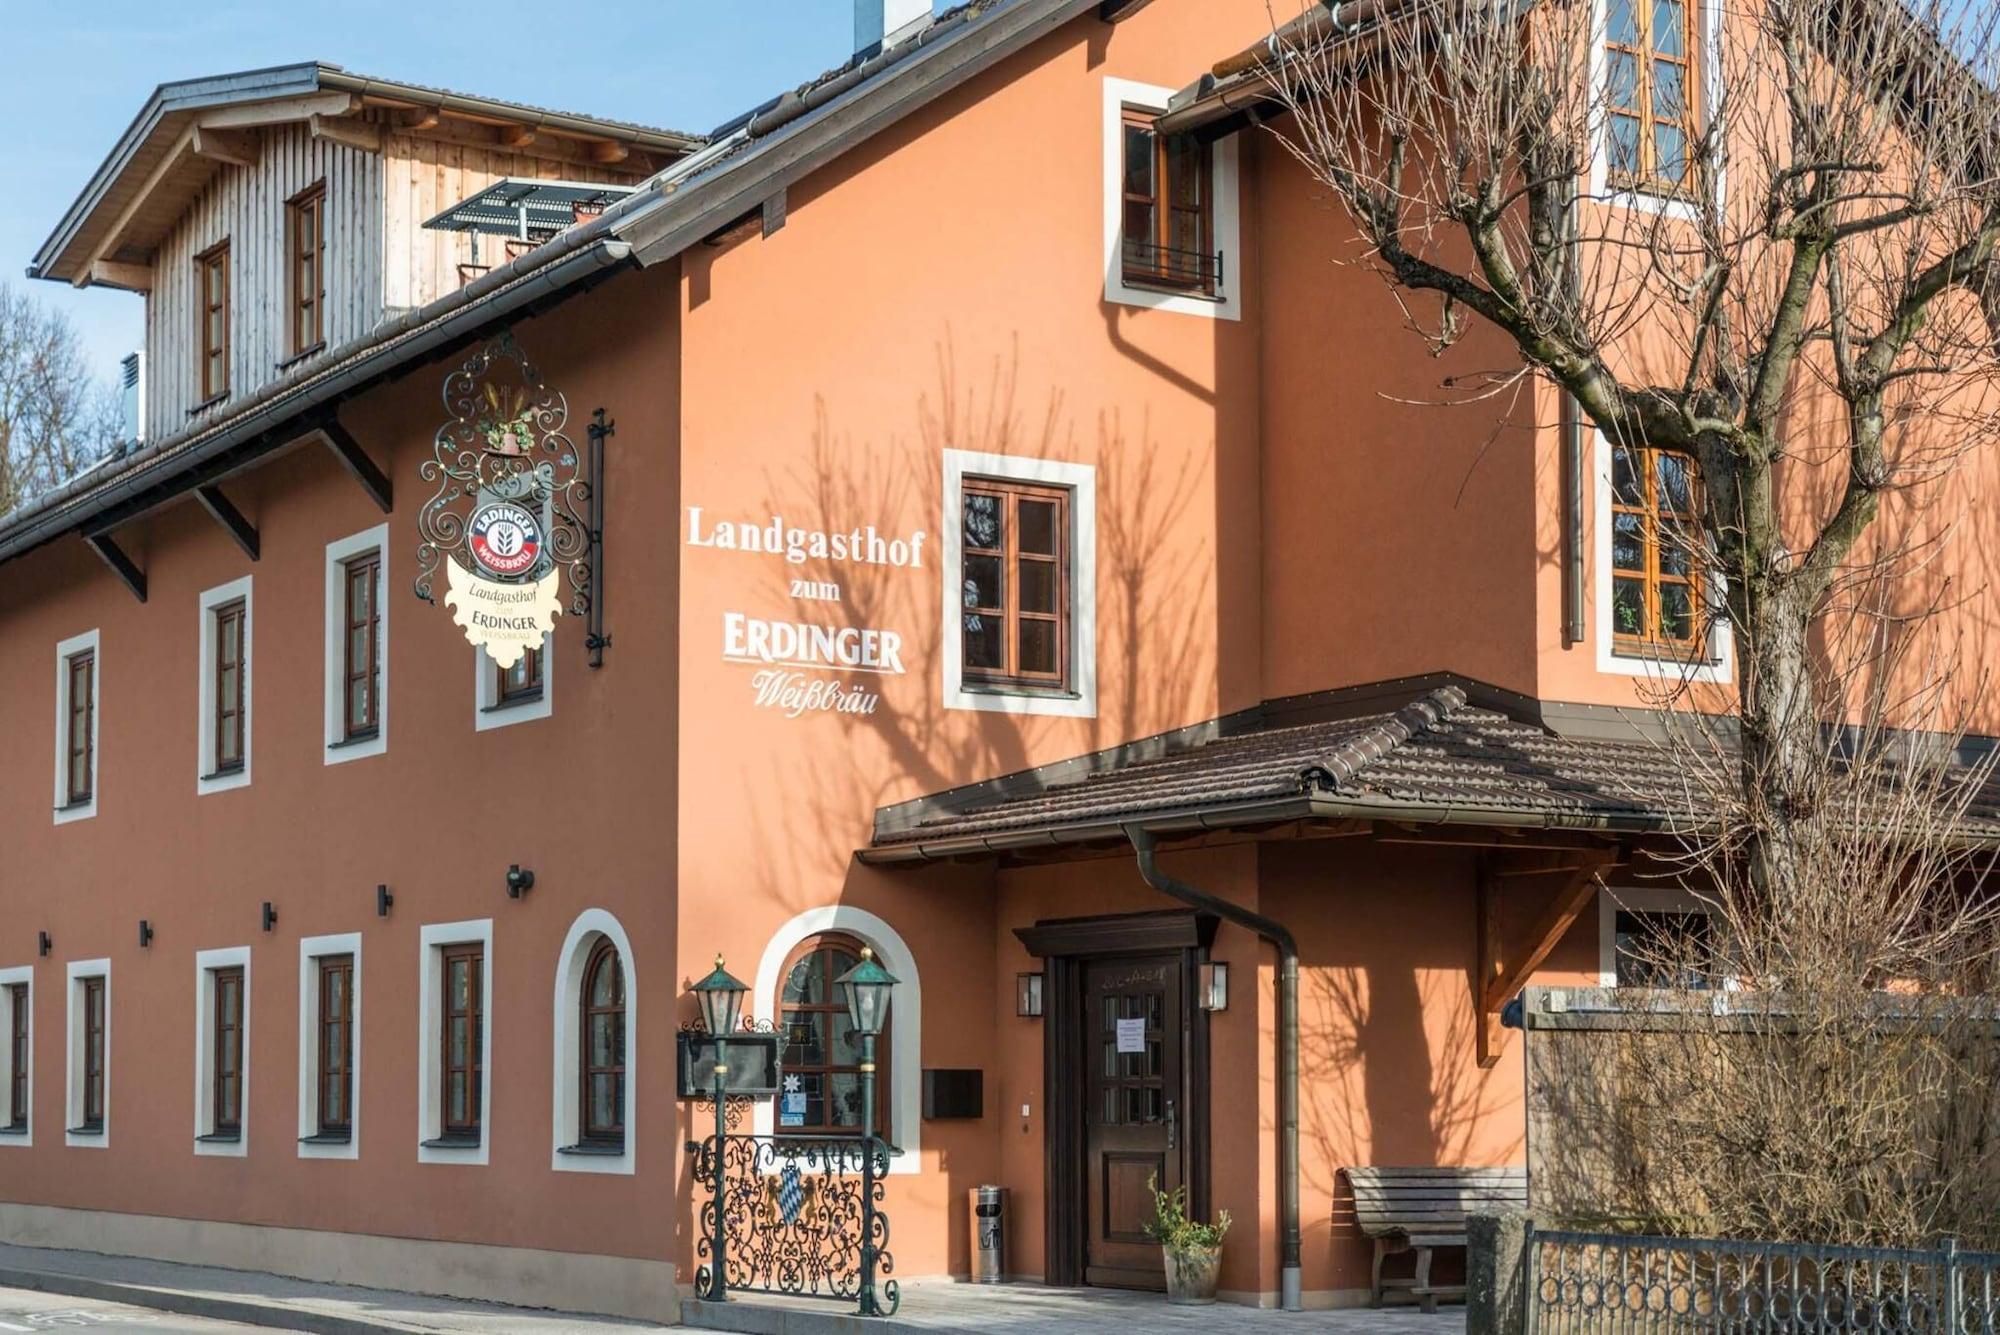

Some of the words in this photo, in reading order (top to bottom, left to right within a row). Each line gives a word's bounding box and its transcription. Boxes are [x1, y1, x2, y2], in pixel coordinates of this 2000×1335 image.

[477, 509, 534, 538] ERDINGER
[687, 507, 926, 568] Landgasthof
[469, 583, 537, 605] Landgasthof
[790, 579, 841, 602] zum
[472, 610, 538, 630] ERDINGER
[724, 613, 906, 674] ERDINGER
[752, 670, 879, 718] Weißbräu
